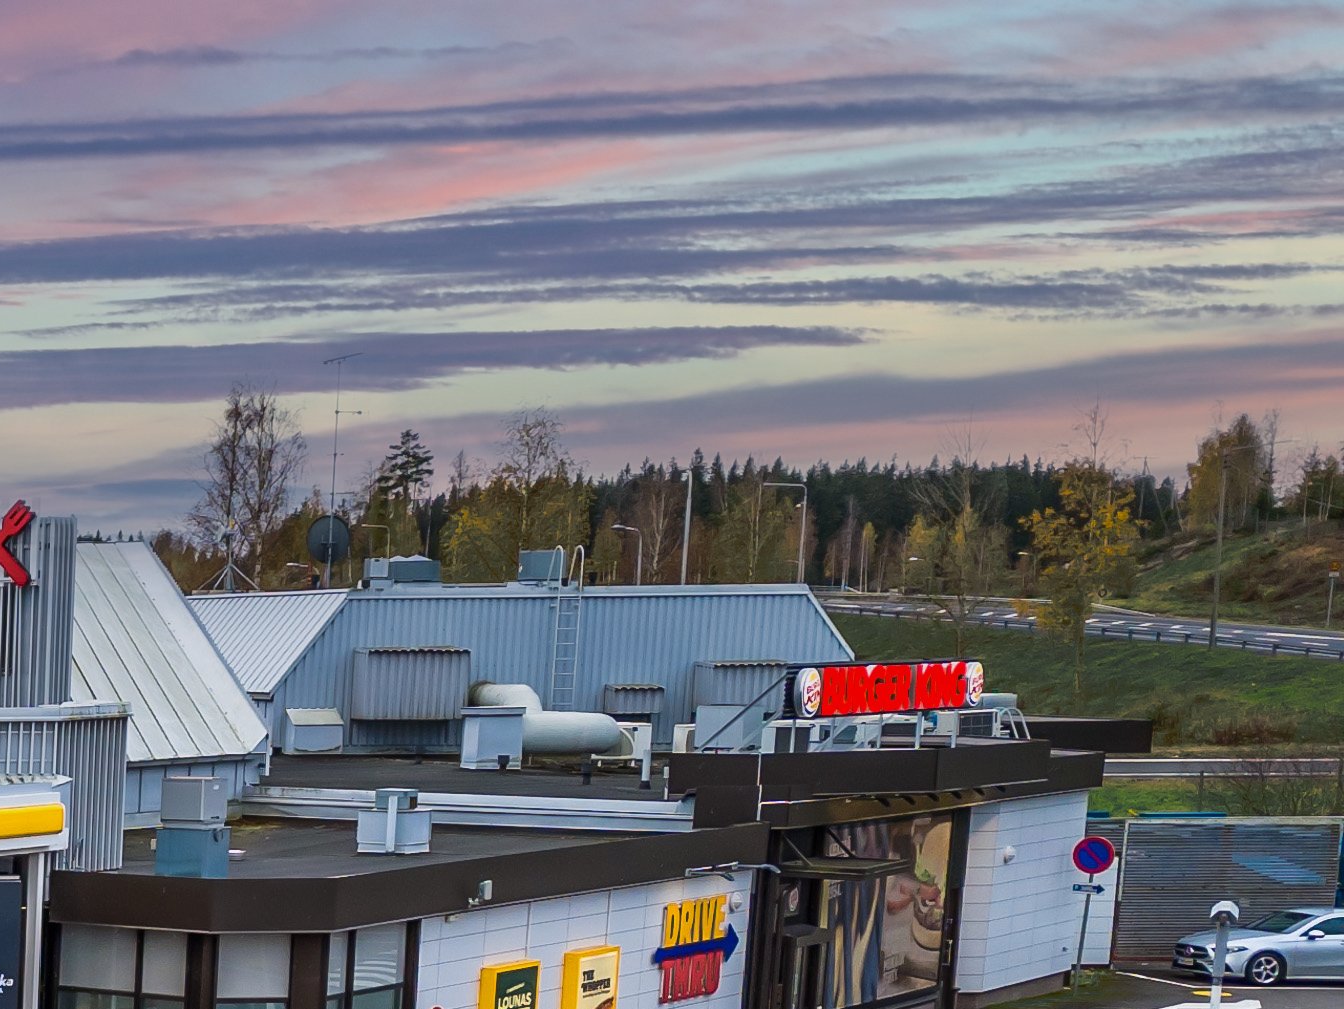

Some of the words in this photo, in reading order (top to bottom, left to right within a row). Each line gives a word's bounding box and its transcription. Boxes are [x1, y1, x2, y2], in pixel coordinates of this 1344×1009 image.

[821, 664, 912, 717] BURGER
[914, 661, 968, 710] KING
[663, 895, 728, 949] DRIVE
[659, 950, 724, 1006] THRU
